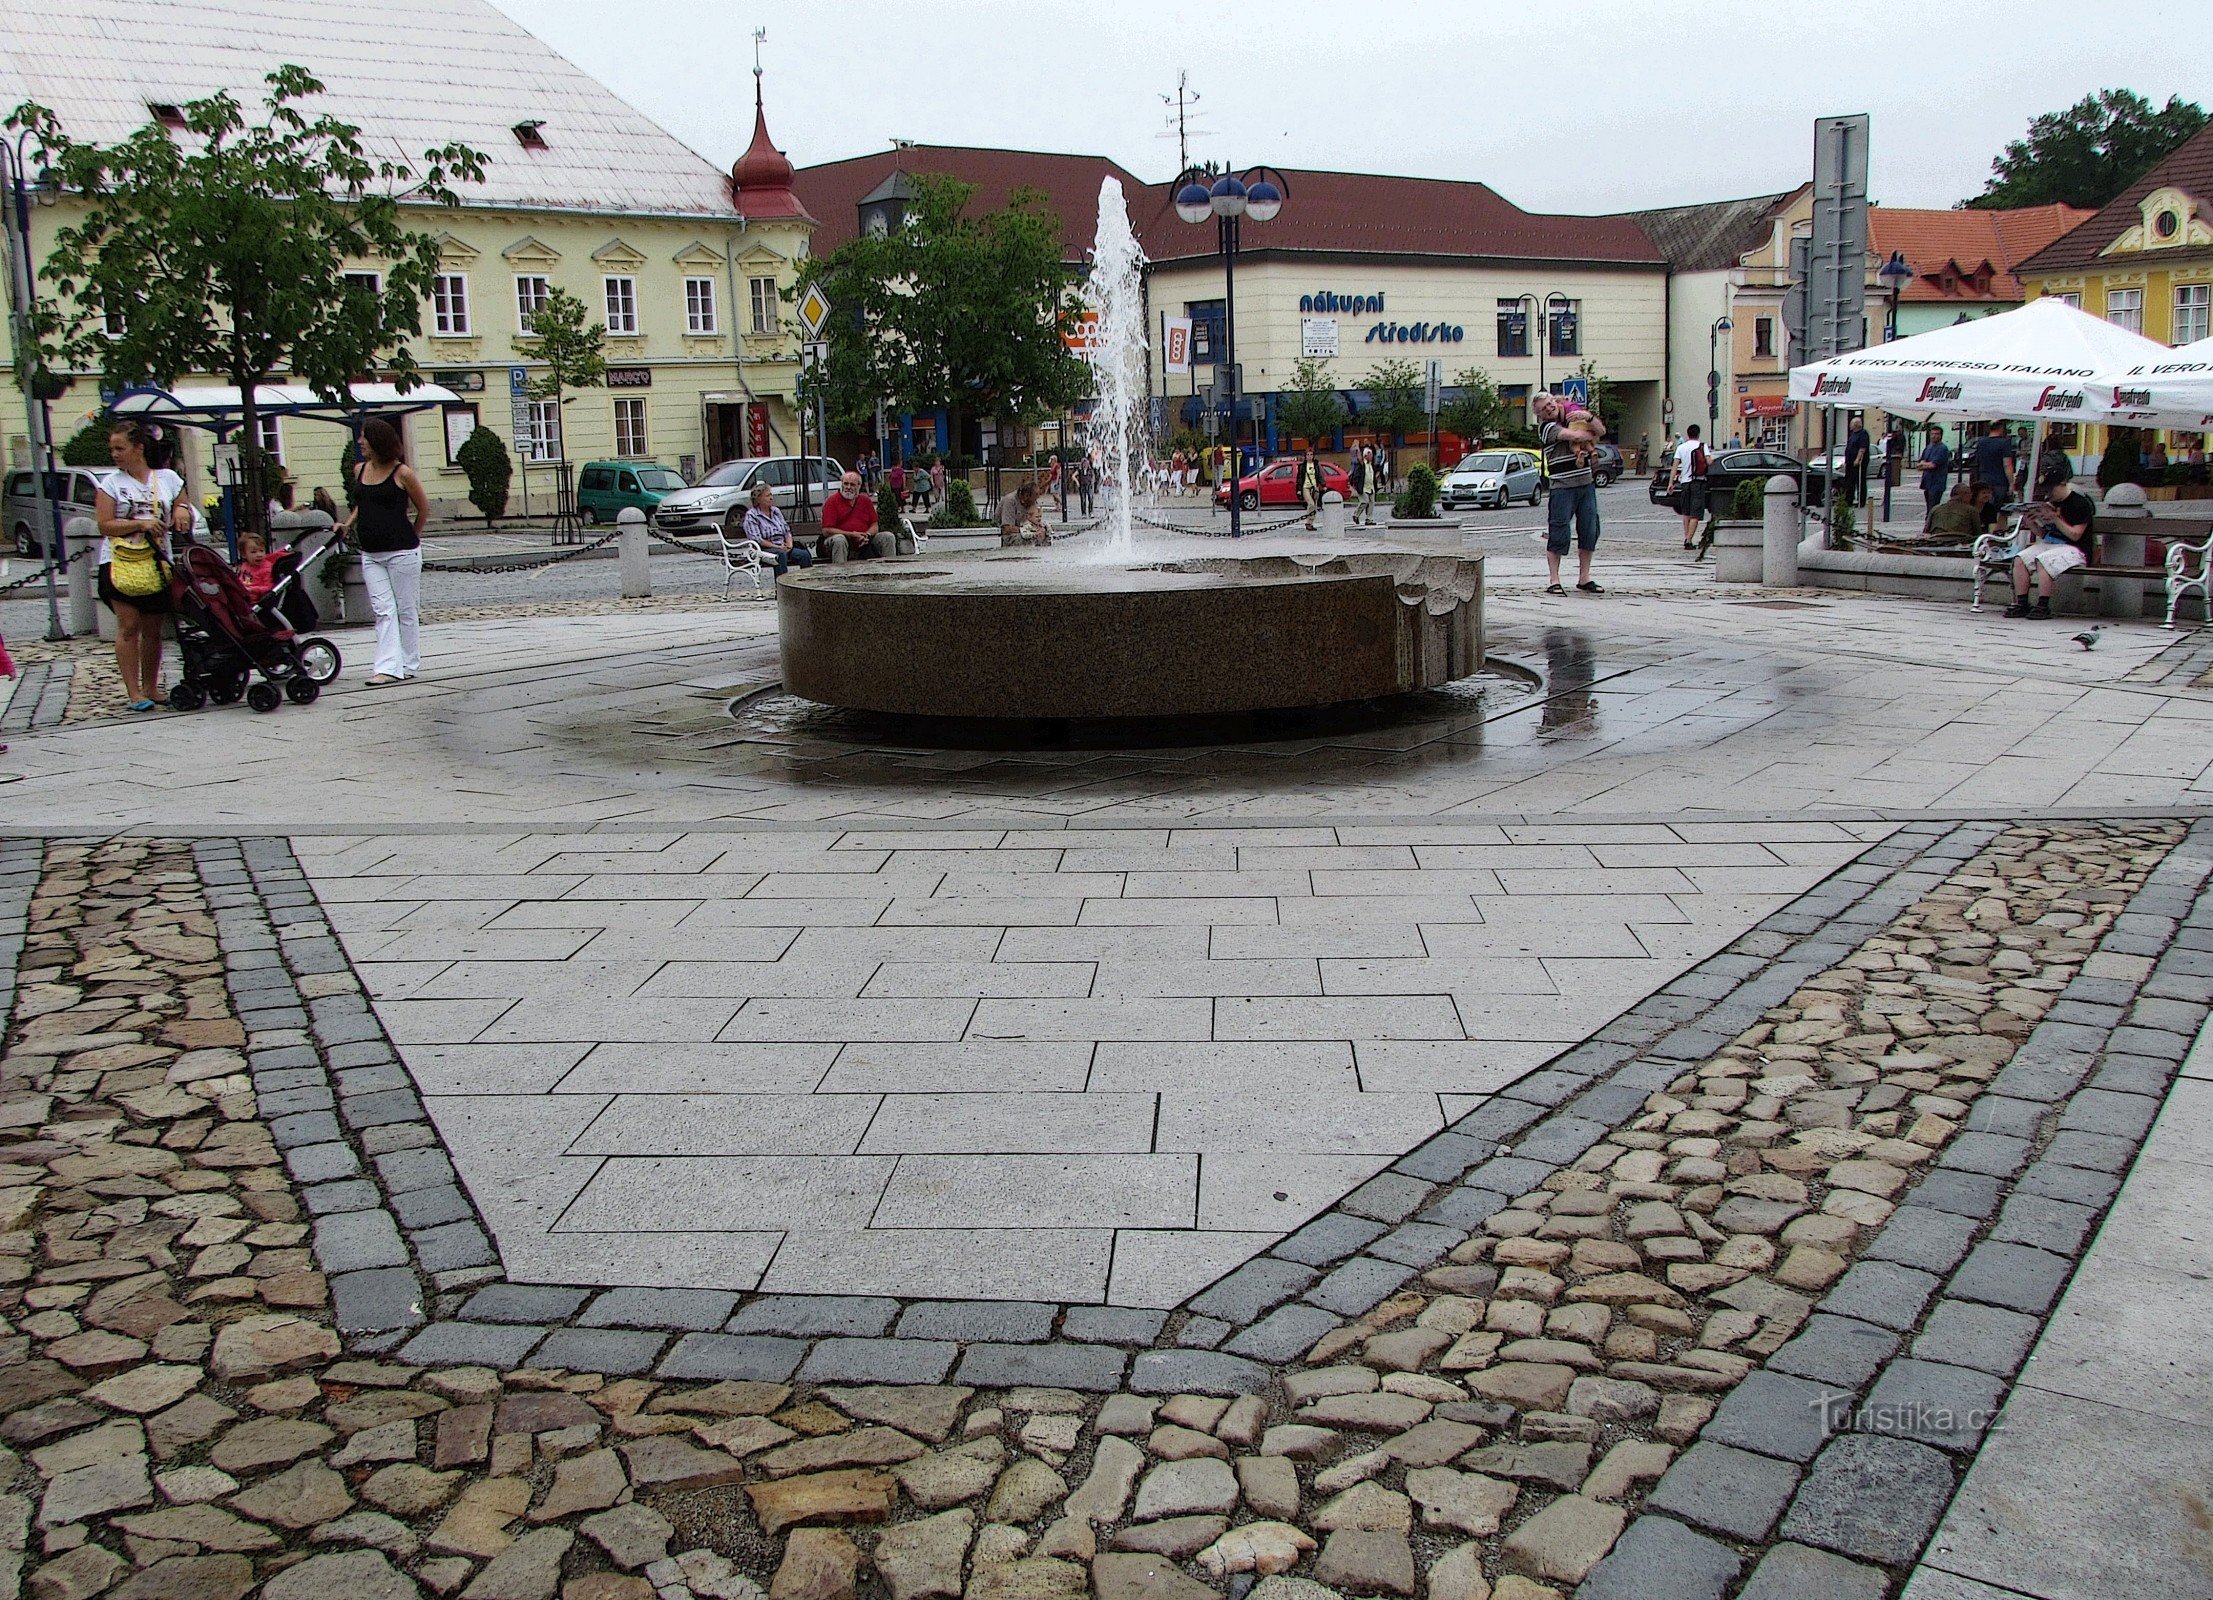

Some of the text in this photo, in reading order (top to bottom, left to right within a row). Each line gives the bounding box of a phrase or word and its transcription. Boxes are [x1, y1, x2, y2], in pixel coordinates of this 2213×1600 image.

[1300, 291, 1385, 317] nákupní
[1364, 322, 1464, 343] středisko
[1827, 358, 2094, 377] IL VERO ESPRESSO ITALIANO
[2126, 366, 2143, 375] IL
[2151, 363, 2205, 374] VERO
[1810, 373, 1851, 397] Segafredo
[1915, 377, 1962, 402] Segafredo
[2032, 385, 2084, 411] Segafredo
[2111, 386, 2151, 408] Segafredo
